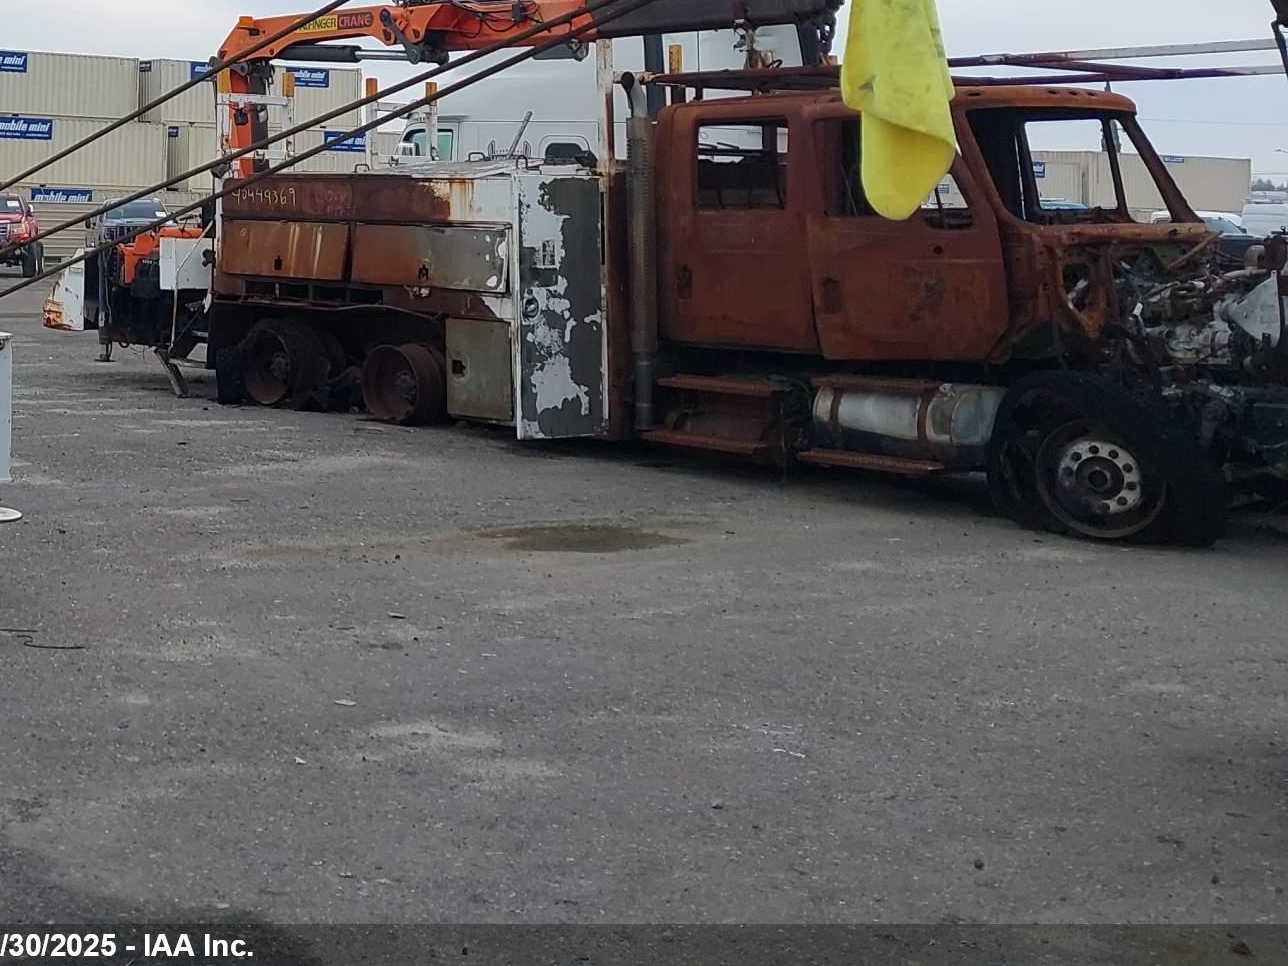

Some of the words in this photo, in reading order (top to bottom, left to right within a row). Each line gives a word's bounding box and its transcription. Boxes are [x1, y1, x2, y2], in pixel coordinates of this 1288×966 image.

[298, 17, 337, 32] FINGER
[339, 13, 372, 28] CRANE
[3, 55, 26, 65] mini
[28, 122, 51, 132] mini
[34, 191, 67, 202] mobile
[67, 193, 91, 202] mini
